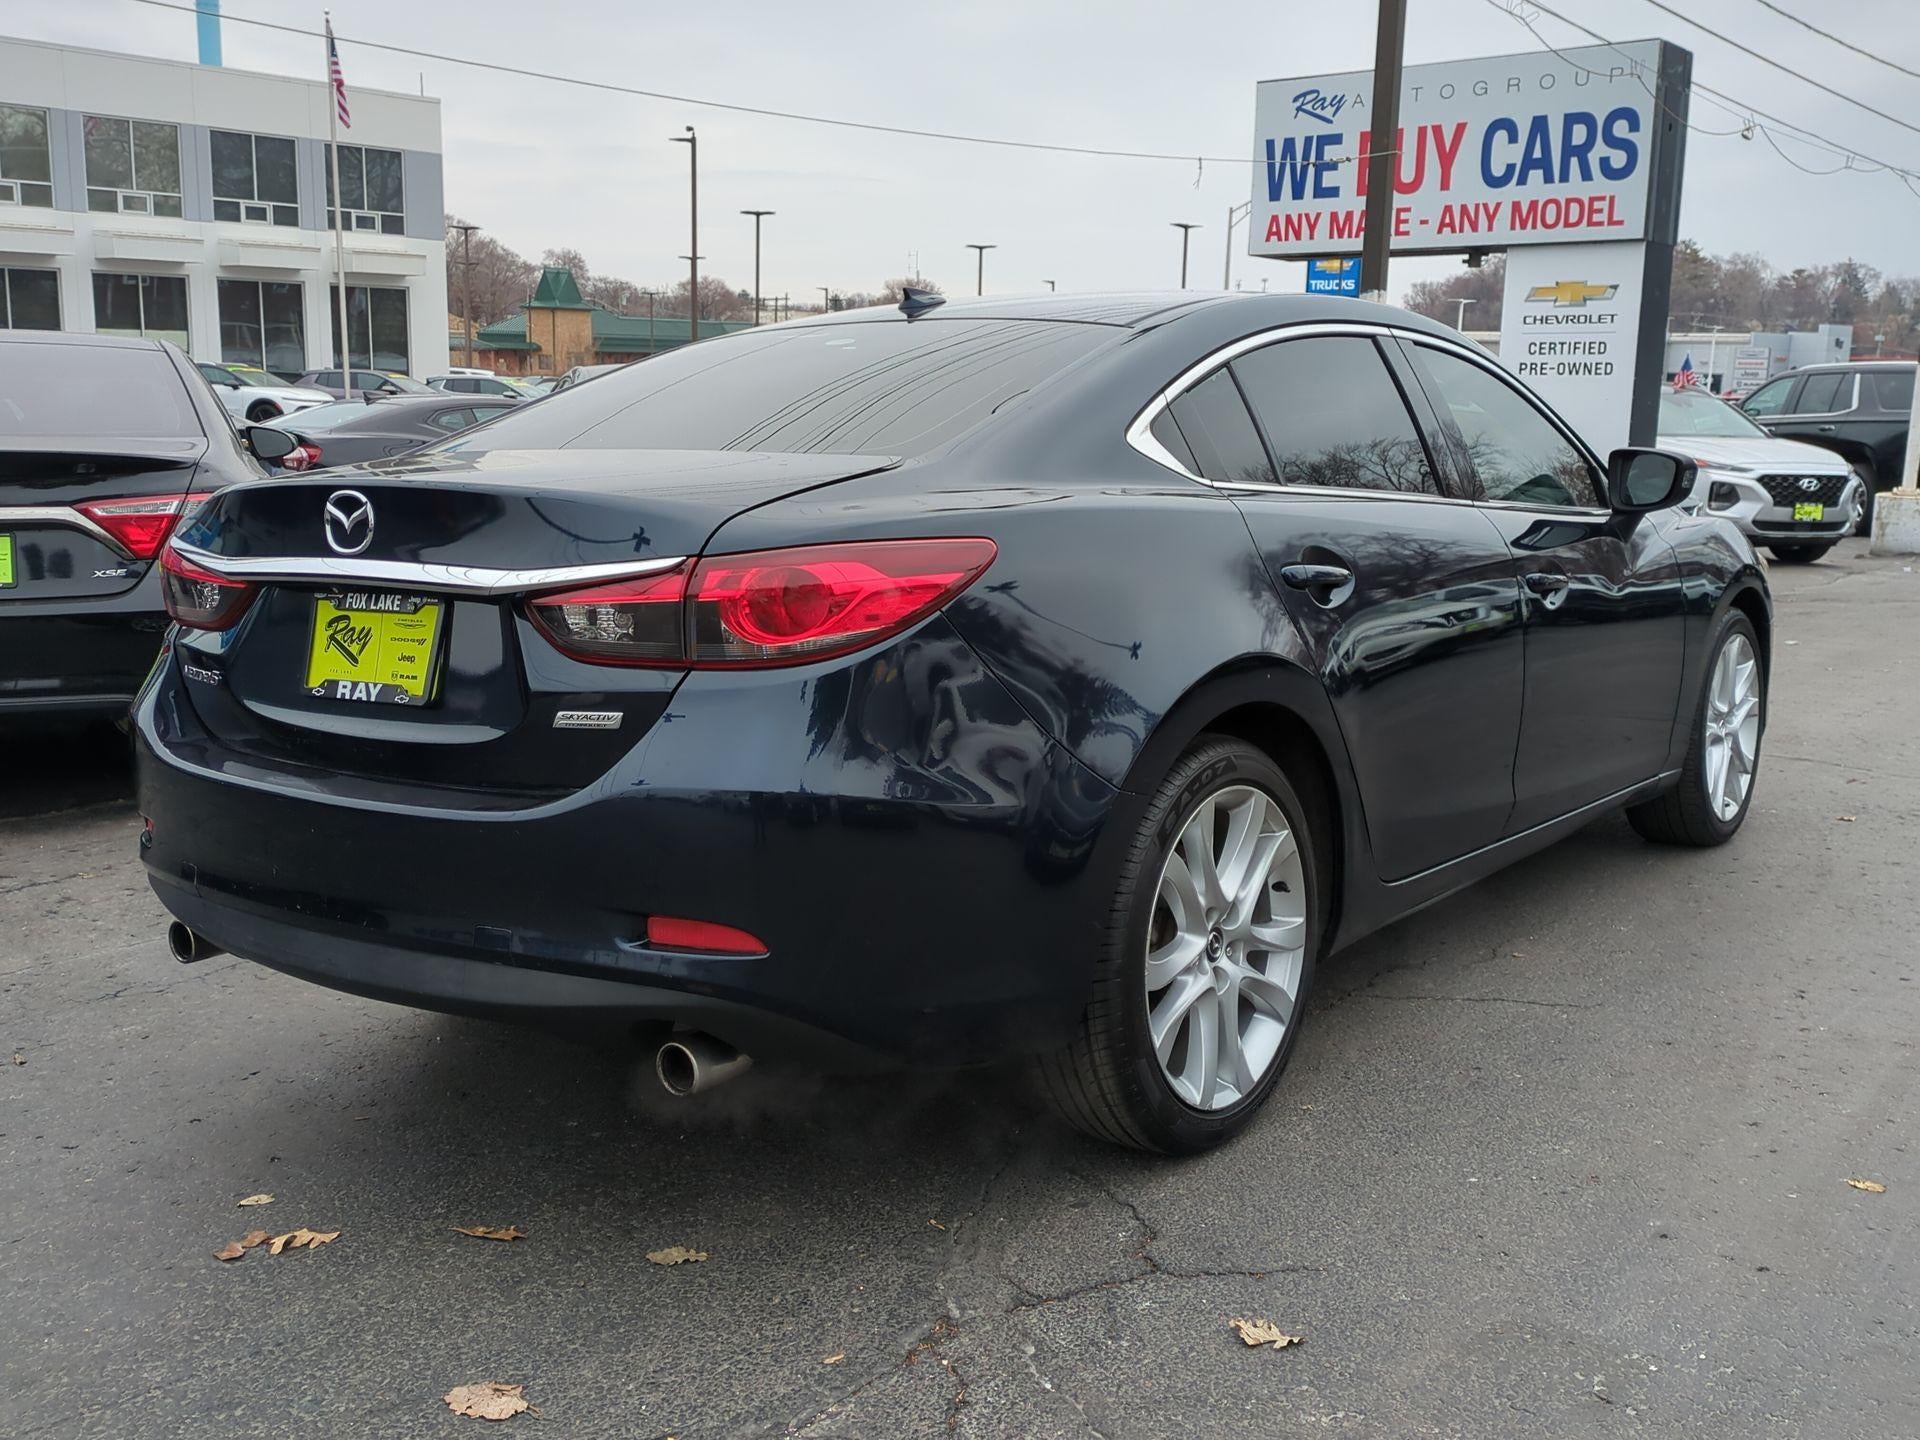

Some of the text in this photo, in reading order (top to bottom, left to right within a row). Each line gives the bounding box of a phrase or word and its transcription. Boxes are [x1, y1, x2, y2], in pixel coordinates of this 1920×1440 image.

[1292, 66, 1624, 124] Ray ATOGROUP
[1266, 133, 1343, 202] WE
[1480, 106, 1641, 189] CARS
[1265, 211, 1322, 242] ANY
[1328, 206, 1412, 240] MAE
[1436, 201, 1503, 235] ANY
[1509, 195, 1625, 231] MODEL
[1310, 279, 1356, 291] TRUCKS
[1523, 313, 1618, 325] CHEVROLET
[1528, 341, 1607, 356] CERTIFIED
[1519, 362, 1614, 376] PRE-OWNED
[91, 568, 128, 578] XSE
[345, 592, 402, 611] FOX LAKE
[324, 614, 373, 668] Ray
[398, 652, 416, 665] Jeep
[399, 673, 418, 681] RAM
[336, 680, 383, 702] RAY
[559, 713, 616, 722] SKYACTIV
